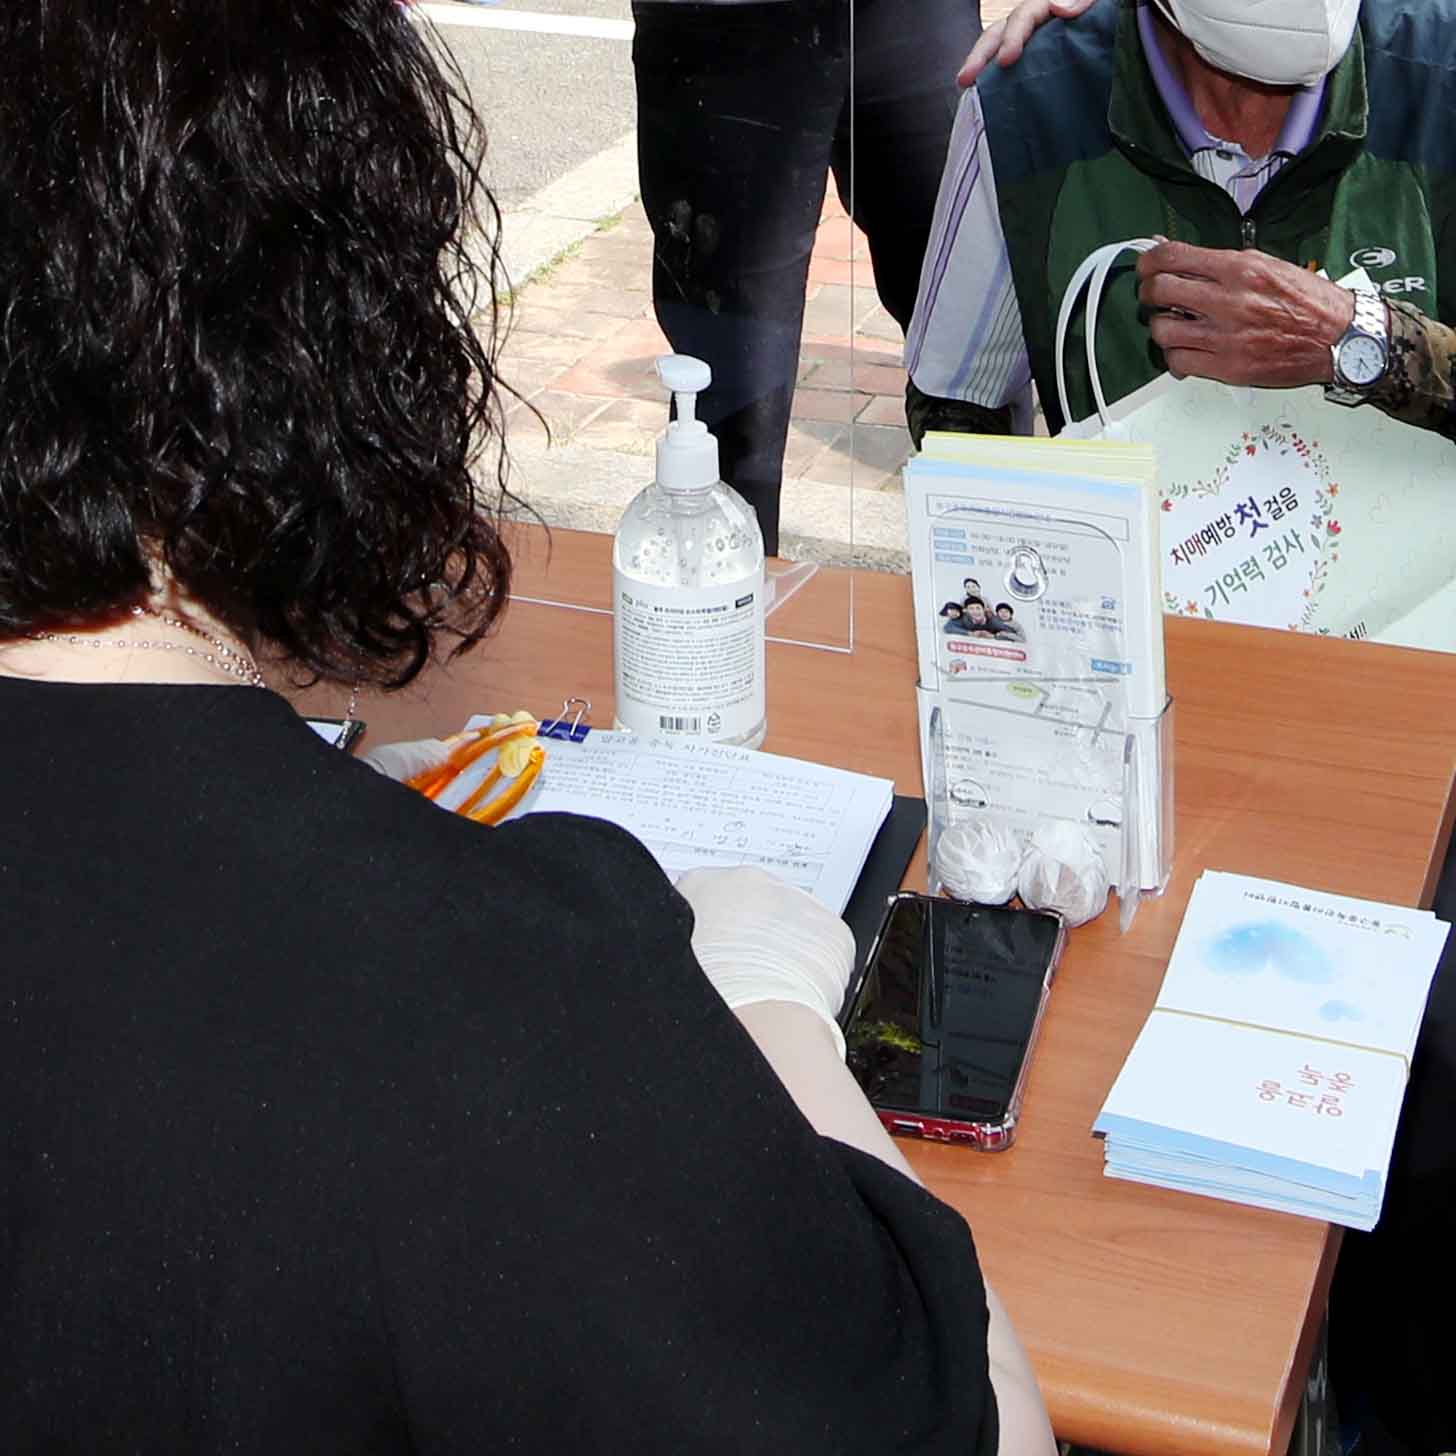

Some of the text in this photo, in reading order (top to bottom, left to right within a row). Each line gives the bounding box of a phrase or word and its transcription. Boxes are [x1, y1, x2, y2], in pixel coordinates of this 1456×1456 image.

[1169, 515, 1236, 569] 치매예방
[1204, 528, 1306, 607] 기억력 검사
